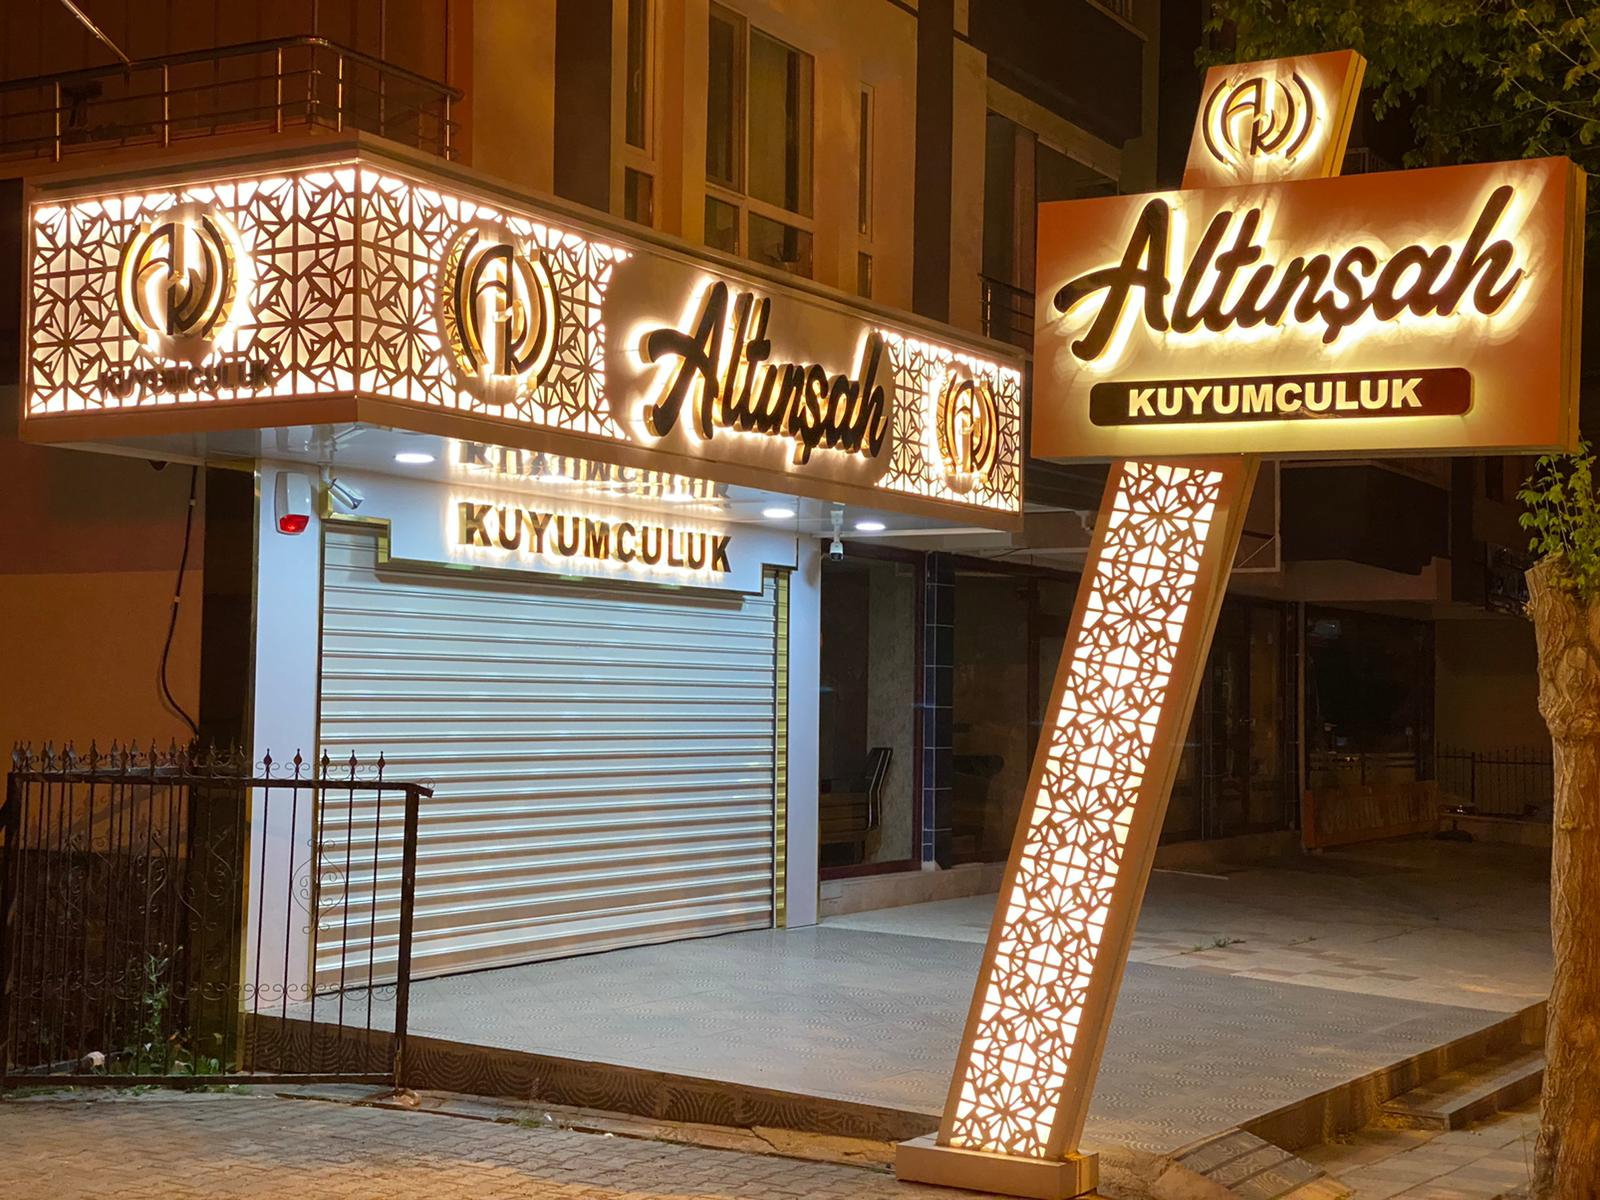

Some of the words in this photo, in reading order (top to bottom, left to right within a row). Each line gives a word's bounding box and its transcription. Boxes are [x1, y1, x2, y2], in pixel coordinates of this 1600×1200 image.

[1053, 184, 1522, 361] Altınşah
[1128, 376, 1423, 418] KUYUMCULUK
[458, 501, 732, 573] KUYUMCULUK
